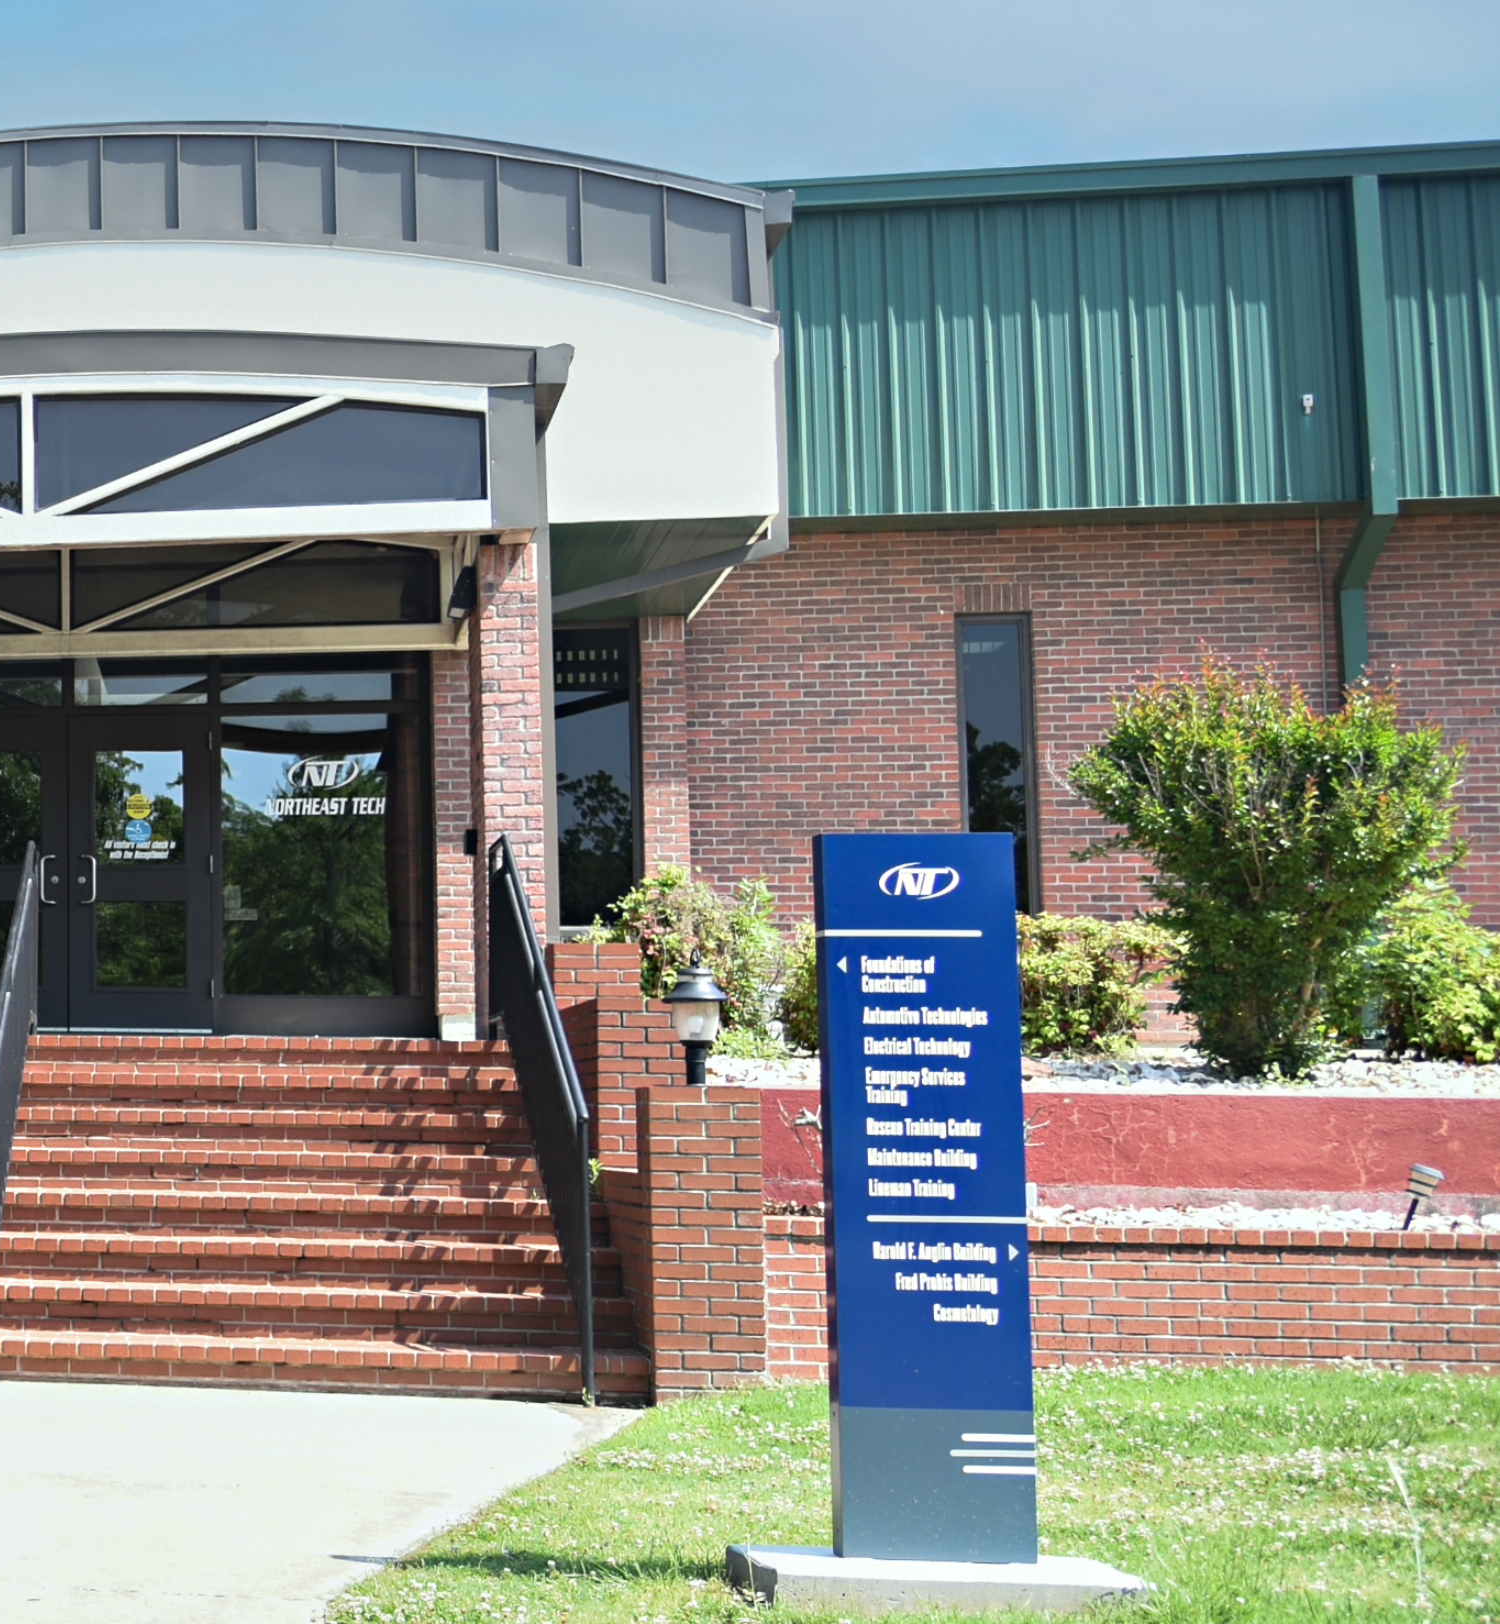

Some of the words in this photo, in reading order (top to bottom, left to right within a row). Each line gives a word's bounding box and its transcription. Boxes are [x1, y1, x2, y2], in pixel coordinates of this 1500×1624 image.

[301, 759, 351, 787] NT
[265, 797, 348, 816] NORTHEAST
[351, 797, 386, 815] TECH
[893, 866, 951, 897] NT
[861, 955, 923, 974] Foundations
[923, 955, 936, 974] of
[861, 974, 927, 993] Construction
[862, 1006, 920, 1025] Automotive
[920, 1006, 988, 1028] Technologies
[863, 1036, 913, 1055] Electrical
[913, 1037, 971, 1058] Technology
[865, 1066, 920, 1088] Emergency
[921, 1067, 966, 1086] Services
[865, 1085, 908, 1107] Training
[866, 1117, 904, 1136] Rescue
[904, 1117, 947, 1139] Training
[947, 1118, 981, 1137] Center
[867, 1147, 933, 1167] Maintenance
[933, 1148, 978, 1170] Building
[868, 1178, 912, 1197] Lineman
[912, 1178, 955, 1200] Training
[872, 1241, 907, 1260] Harold
[907, 1242, 917, 1260] F.
[918, 1242, 952, 1263] Anglin
[953, 1242, 997, 1264] Building
[895, 1272, 919, 1291] Fred
[954, 1273, 998, 1295] Building
[933, 1303, 1000, 1326] Cosmetology
